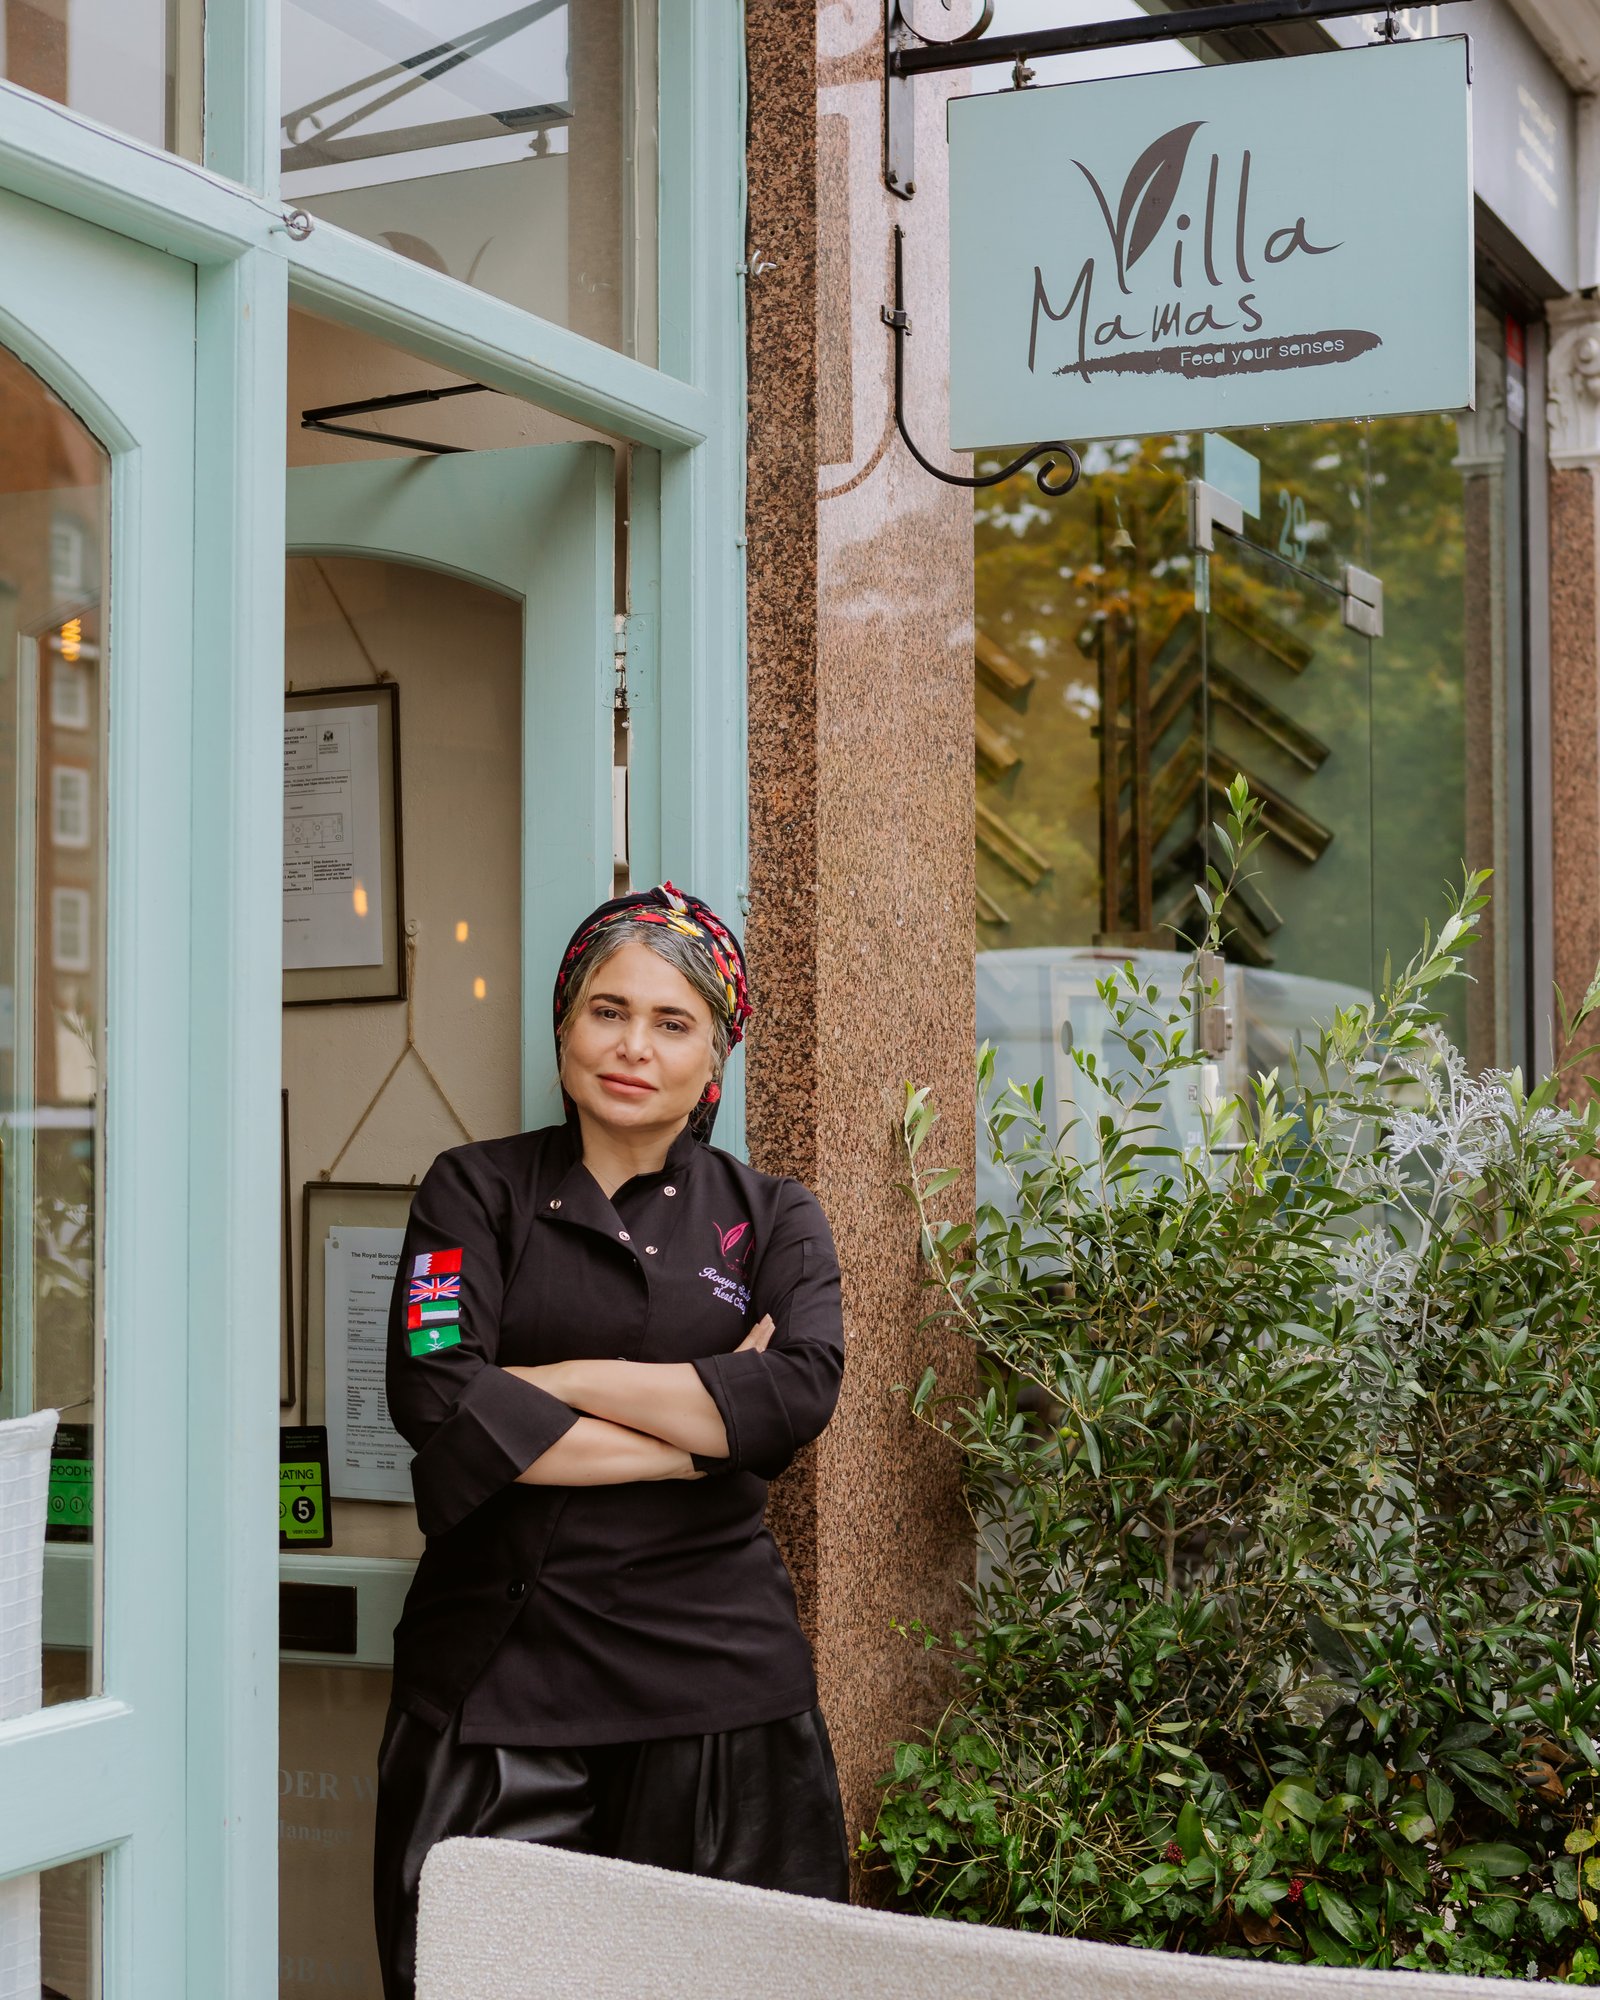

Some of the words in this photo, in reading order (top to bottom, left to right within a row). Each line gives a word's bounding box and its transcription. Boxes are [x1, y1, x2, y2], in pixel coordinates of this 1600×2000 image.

[1070, 120, 1345, 294] Villa
[1027, 257, 1264, 384] Mamas
[1180, 348, 1226, 367] Feed
[1231, 345, 1273, 366] your
[1278, 339, 1345, 357] senses
[361, 1252, 377, 1260] Royal
[698, 1266, 738, 1291] Roaya
[712, 1285, 736, 1304] Head
[51, 1465, 82, 1477] FOOD
[84, 1465, 94, 1477] H
[298, 1500, 310, 1520] 5
